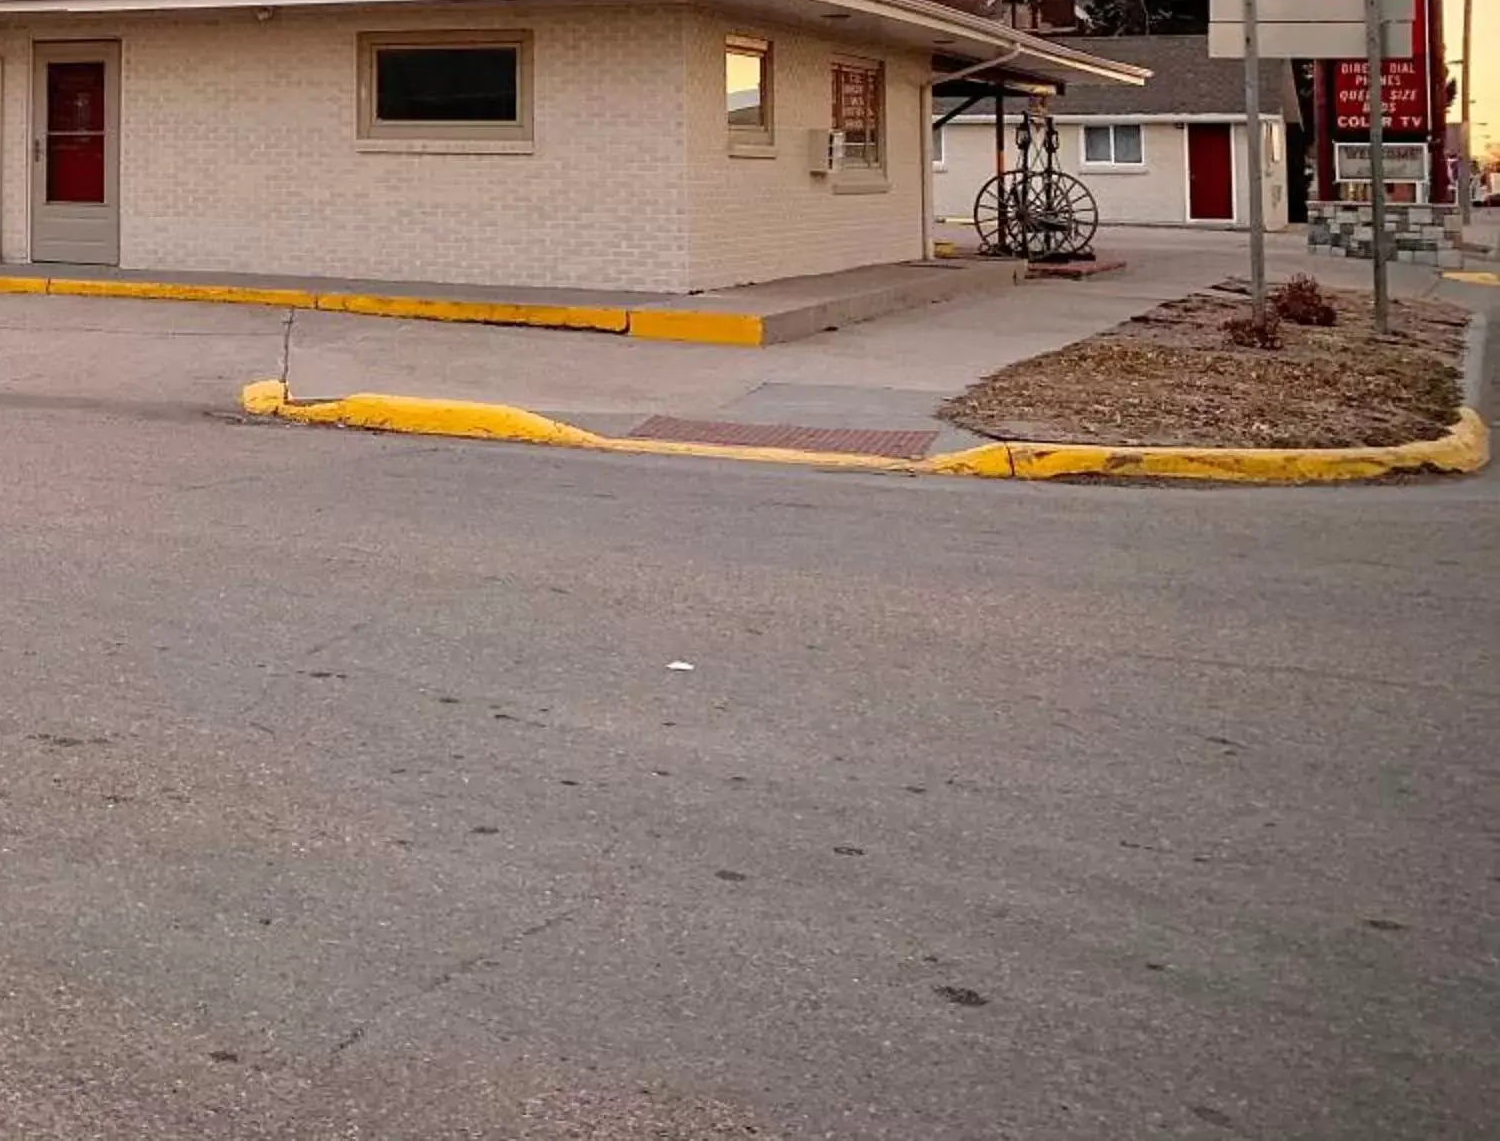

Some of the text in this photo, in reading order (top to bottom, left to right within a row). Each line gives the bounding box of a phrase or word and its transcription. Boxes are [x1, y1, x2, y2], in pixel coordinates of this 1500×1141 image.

[1341, 62, 1416, 74] DIRE DIAL
[1355, 74, 1401, 86] PHNES
[1339, 89, 1418, 103] QUEE SIZE
[1362, 101, 1397, 114] BDS
[1337, 116, 1422, 128] COLR TV
